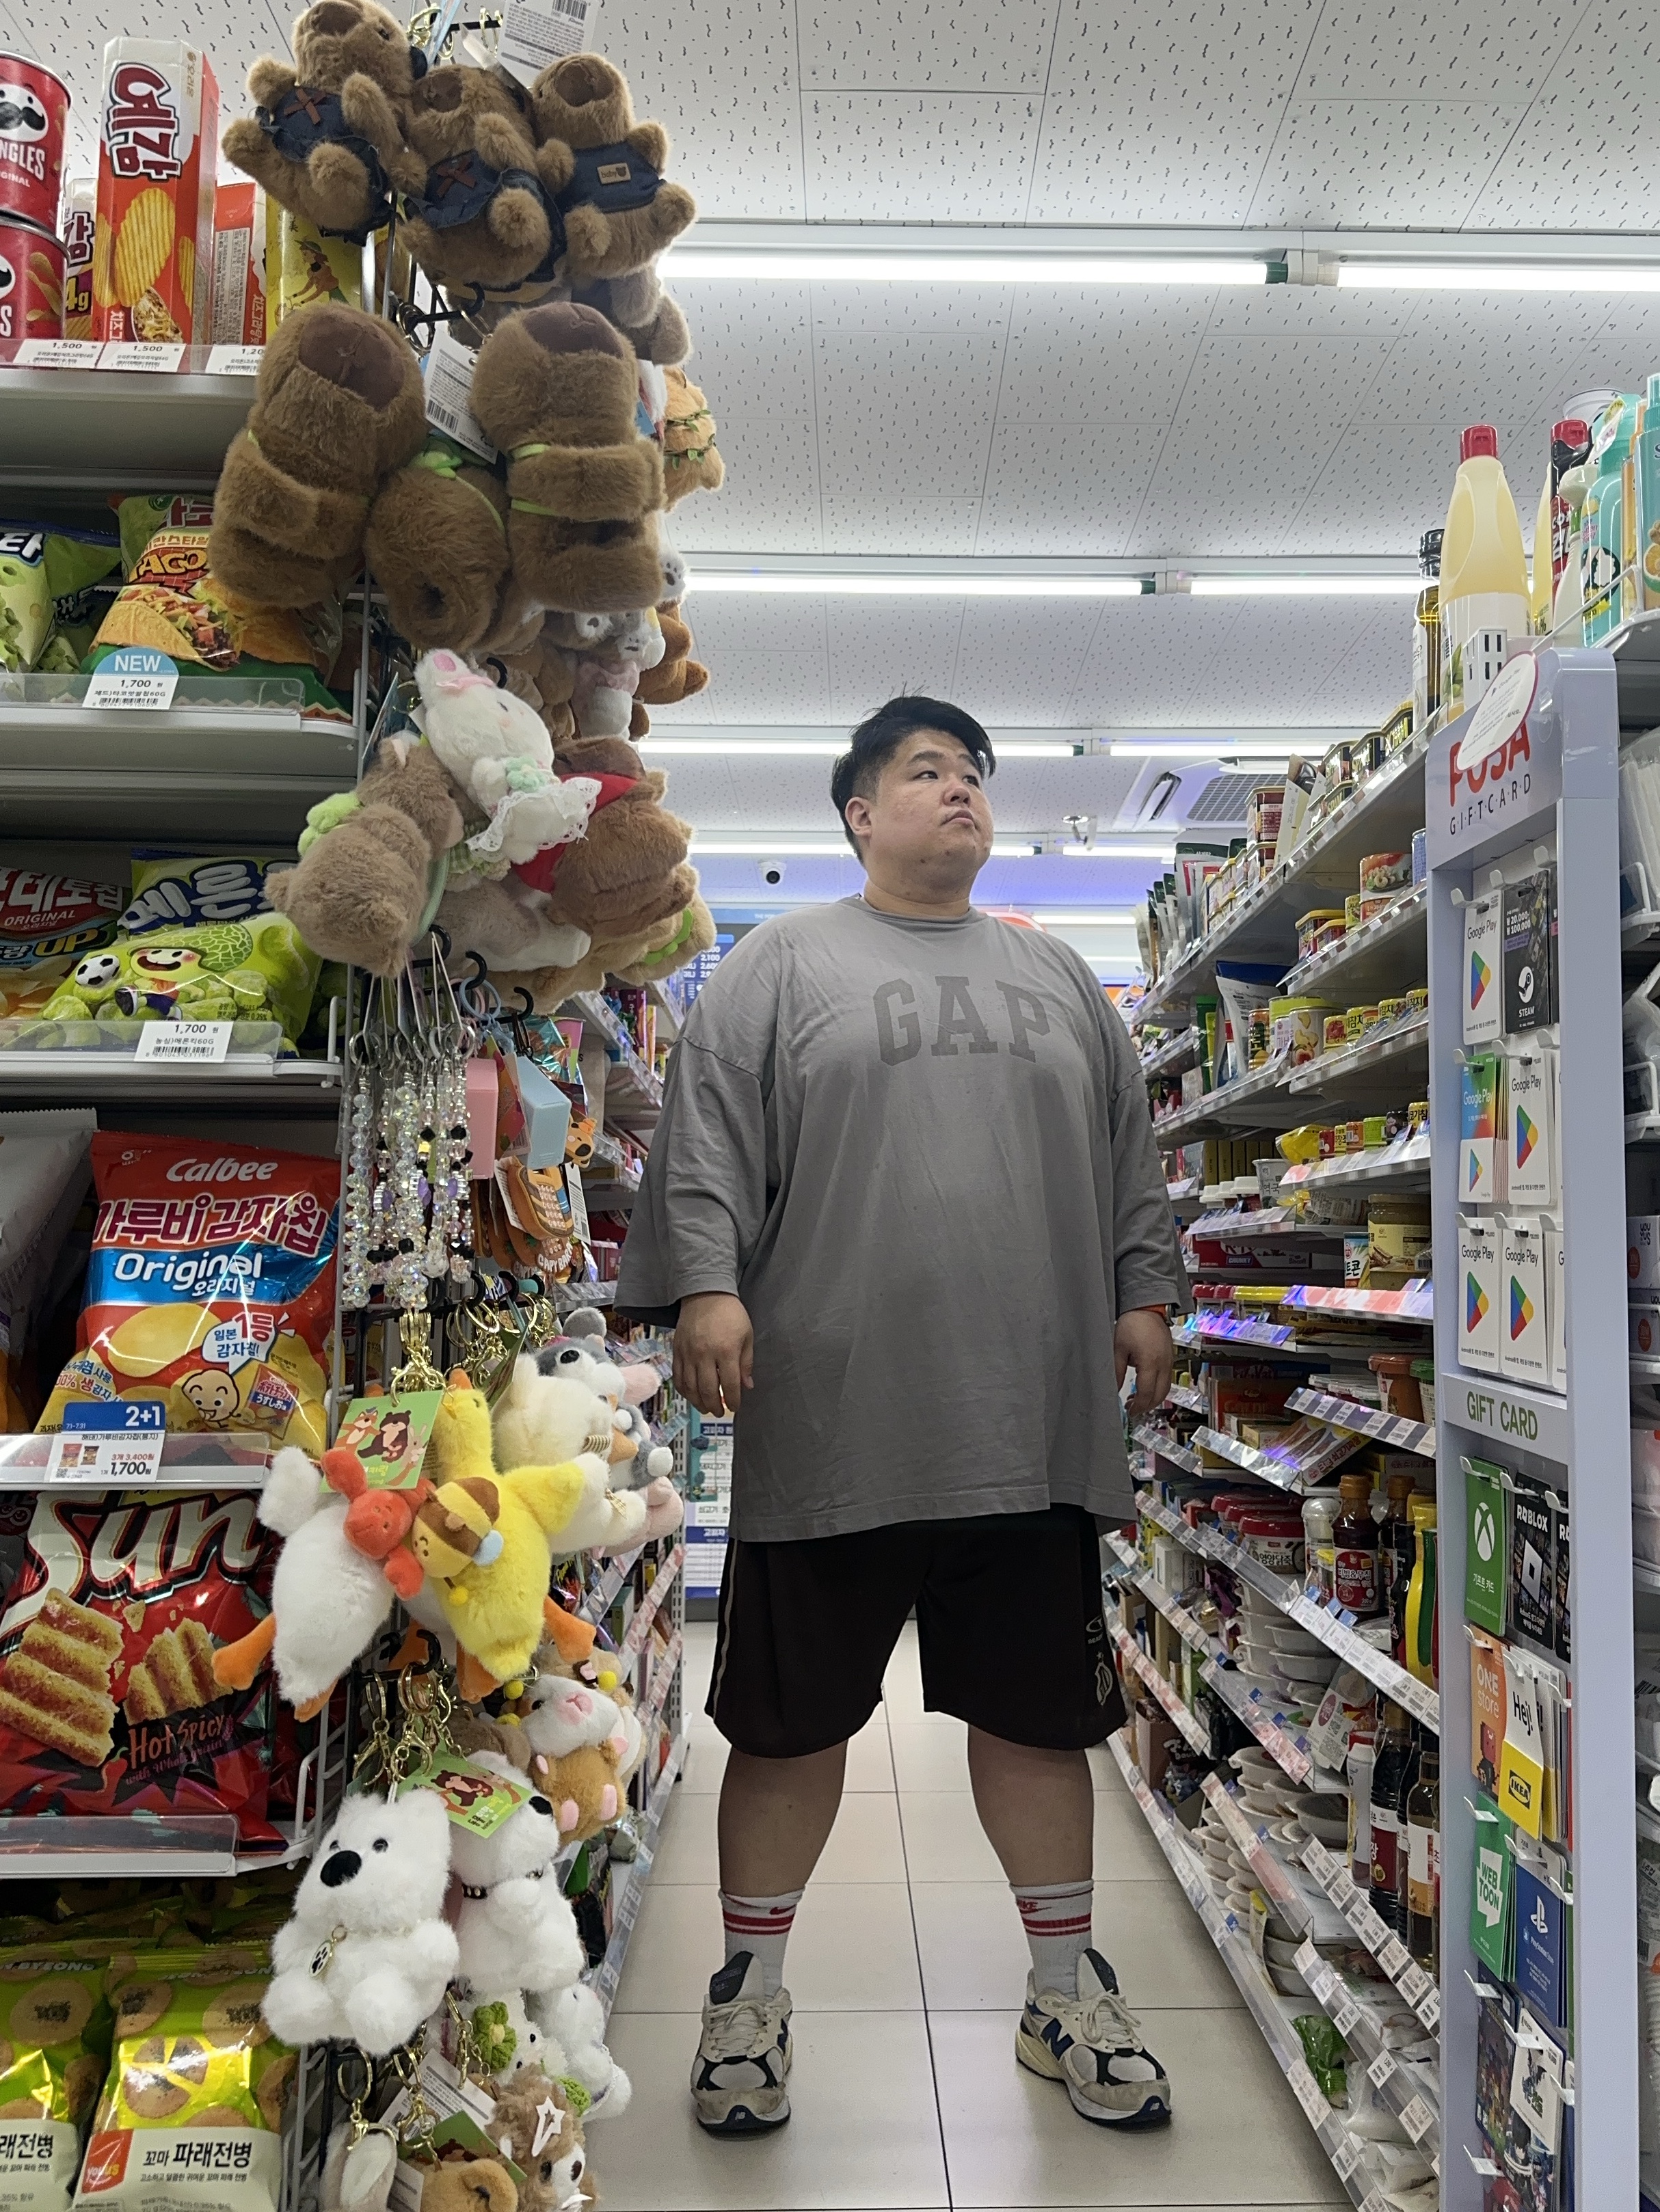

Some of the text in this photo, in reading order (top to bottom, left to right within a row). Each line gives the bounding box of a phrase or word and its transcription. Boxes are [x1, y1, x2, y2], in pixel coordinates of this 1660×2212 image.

[109, 64, 181, 178] 예감
[114, 655, 161, 672] NEW
[120, 679, 151, 688] 1,700
[4, 910, 76, 926] ORIGINAL
[1467, 919, 1497, 940] Google Play
[35, 928, 98, 956] UP
[872, 975, 1051, 1066] GAP
[1518, 1006, 1535, 1018] STEAM
[174, 1024, 206, 1034] 1,700
[1512, 1076, 1542, 1094] Google Play
[165, 1157, 280, 1183] Calbee
[1461, 1244, 1495, 1263] Google Play
[1505, 1247, 1525, 1265] Google
[1526, 1249, 1538, 1267] Play
[114, 1250, 263, 1292] Original
[191, 1279, 256, 1297] 오리지널
[214, 1311, 274, 1343] 일본 1등
[217, 1343, 260, 1358] 감자칩!
[125, 1405, 161, 1427] 2+1
[1467, 1390, 1538, 1441] GIFT CARD
[1517, 1504, 1548, 1533] ROBLOX
[0, 1490, 265, 1634] Sun
[1259, 1554, 1292, 1566] 영양닭죽
[1476, 1662, 1499, 1699] ONE
[1477, 1688, 1500, 1718] store
[1512, 1690, 1534, 1737] Hej!
[129, 1724, 171, 1770] Hot
[1511, 1776, 1530, 1801] IKEA
[1481, 1861, 1499, 1891] WEB
[1478, 1877, 1500, 1911] TOON
[142, 2141, 252, 2168] 꼬마 파래전병
